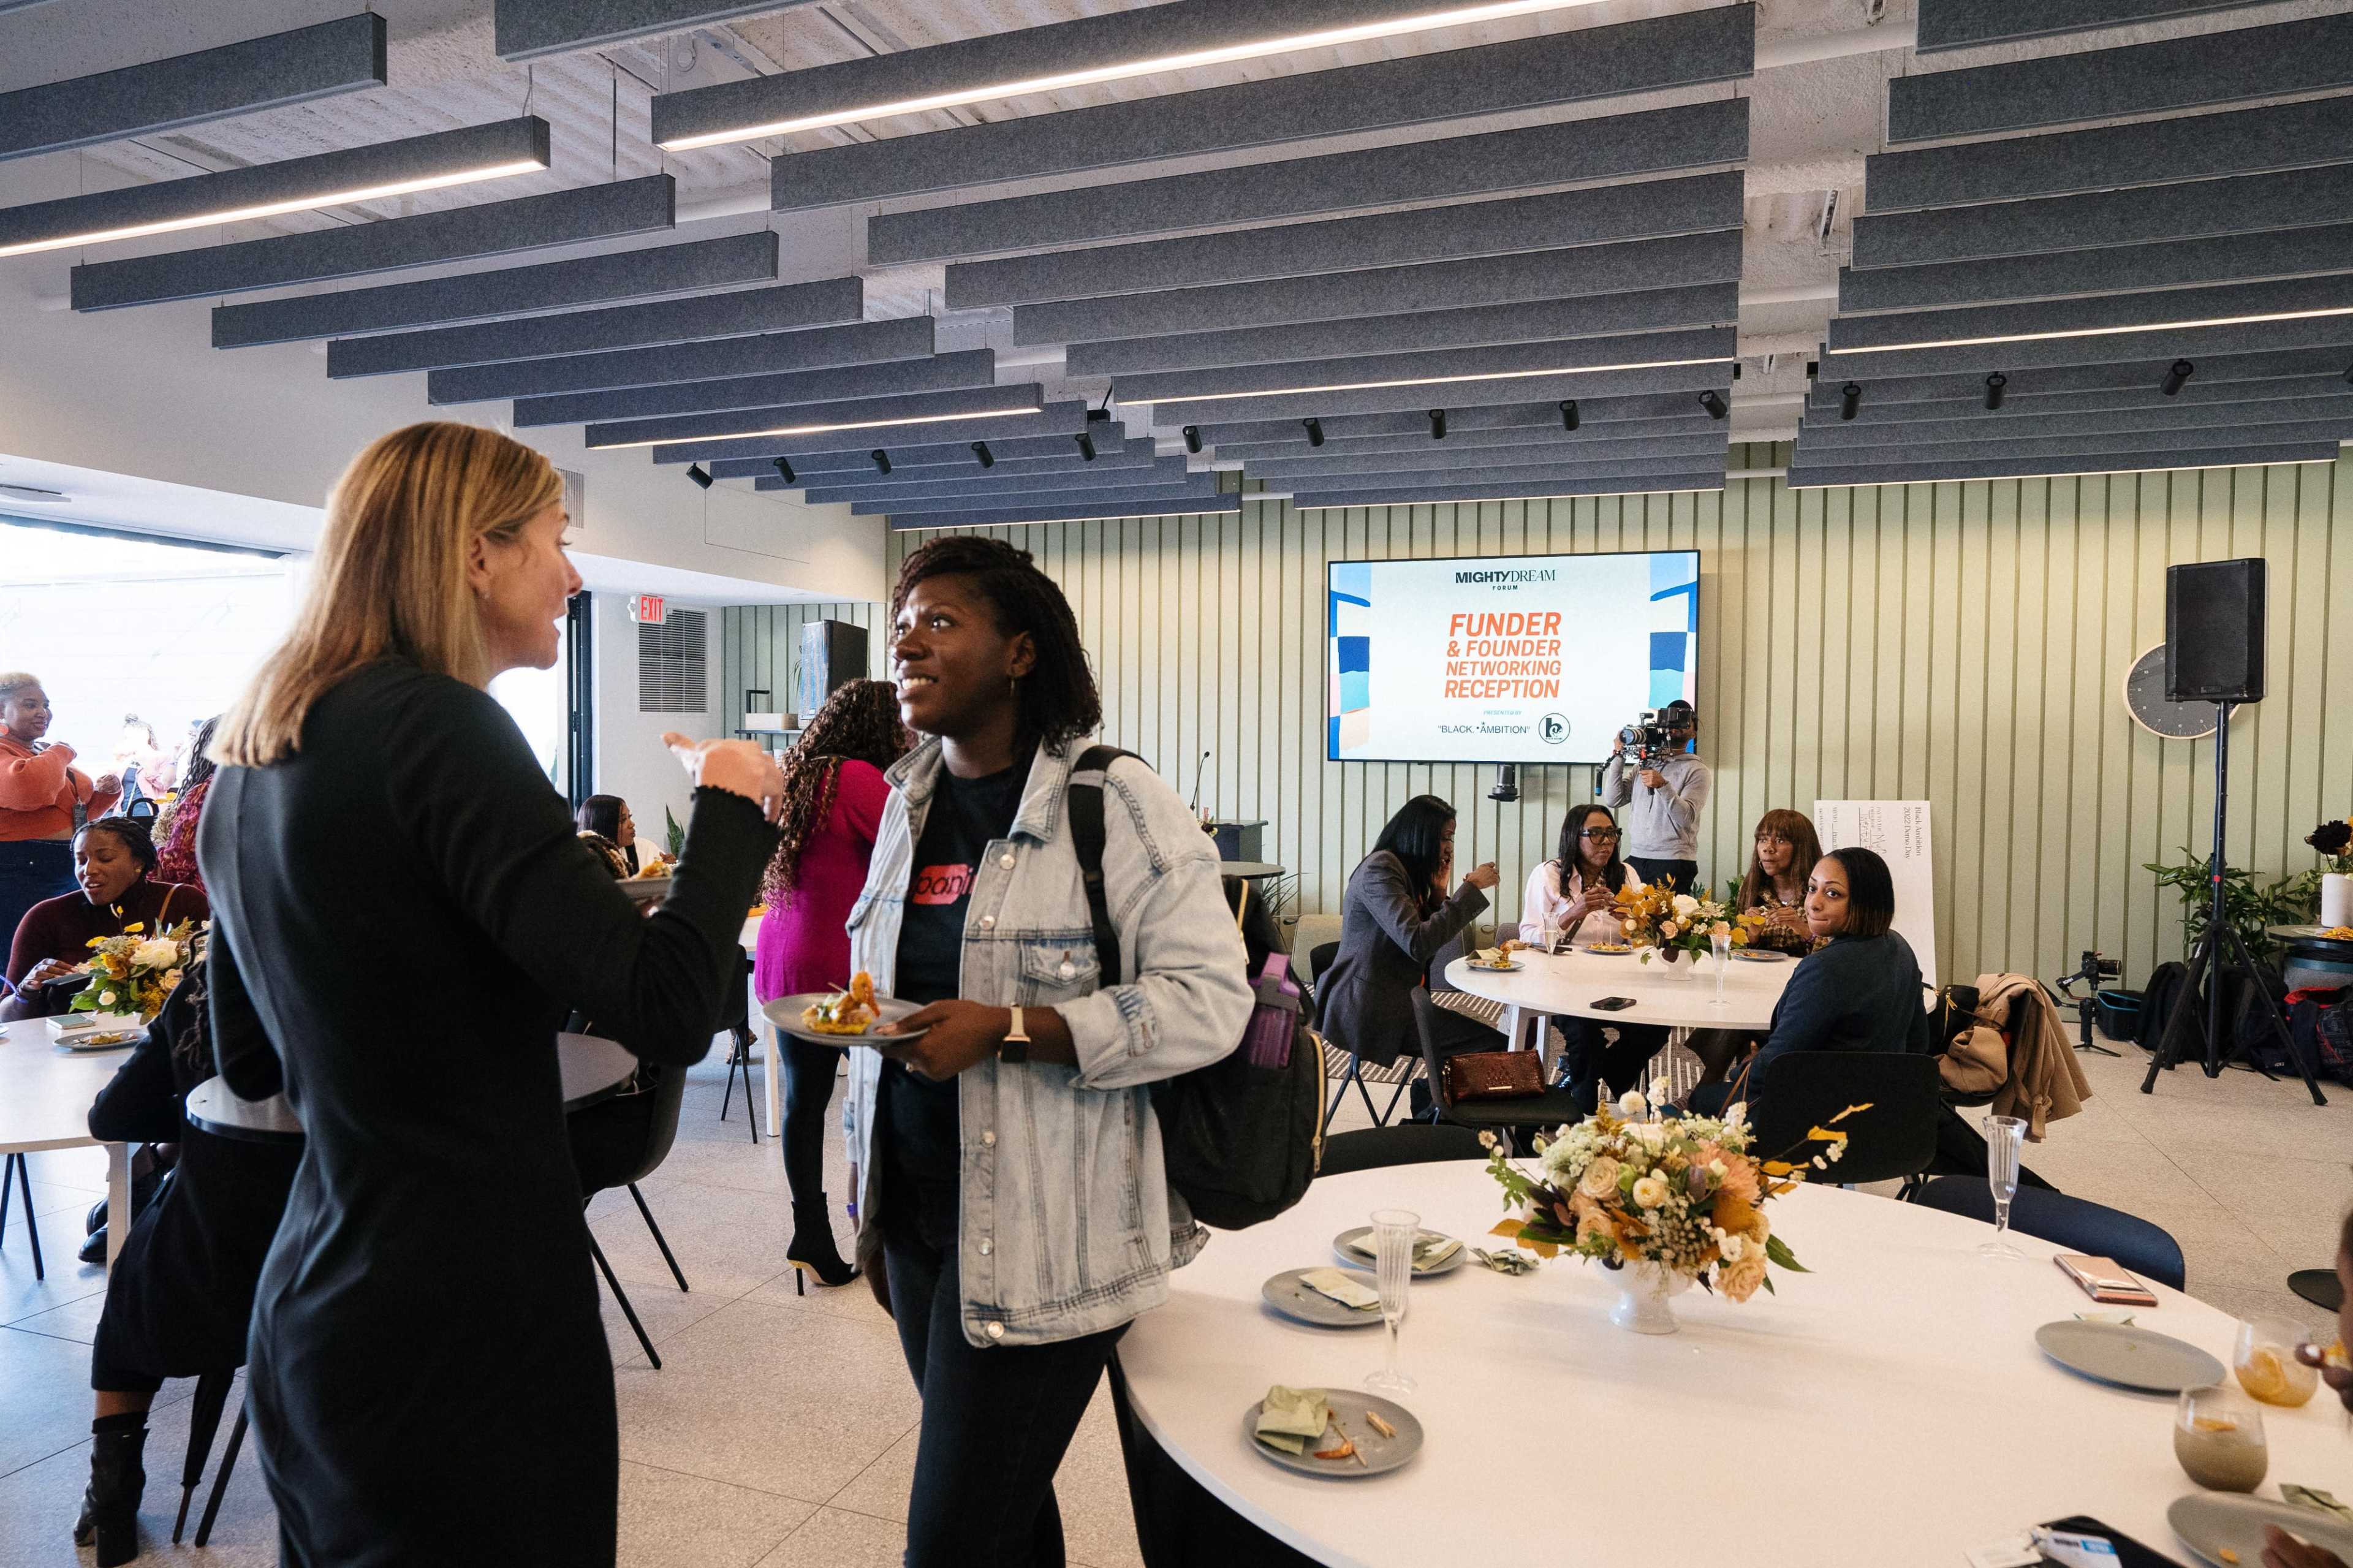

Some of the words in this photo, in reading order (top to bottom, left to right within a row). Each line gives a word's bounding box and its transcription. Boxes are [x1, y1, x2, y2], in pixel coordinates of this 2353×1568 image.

[641, 597, 663, 622] EXIT
[1449, 612, 1562, 637] FUNDER
[1447, 640, 1461, 657] &
[1466, 639, 1561, 657] FOUNDER
[1446, 660, 1562, 676] NETWORKING
[1445, 679, 1560, 699] RECEPTION
